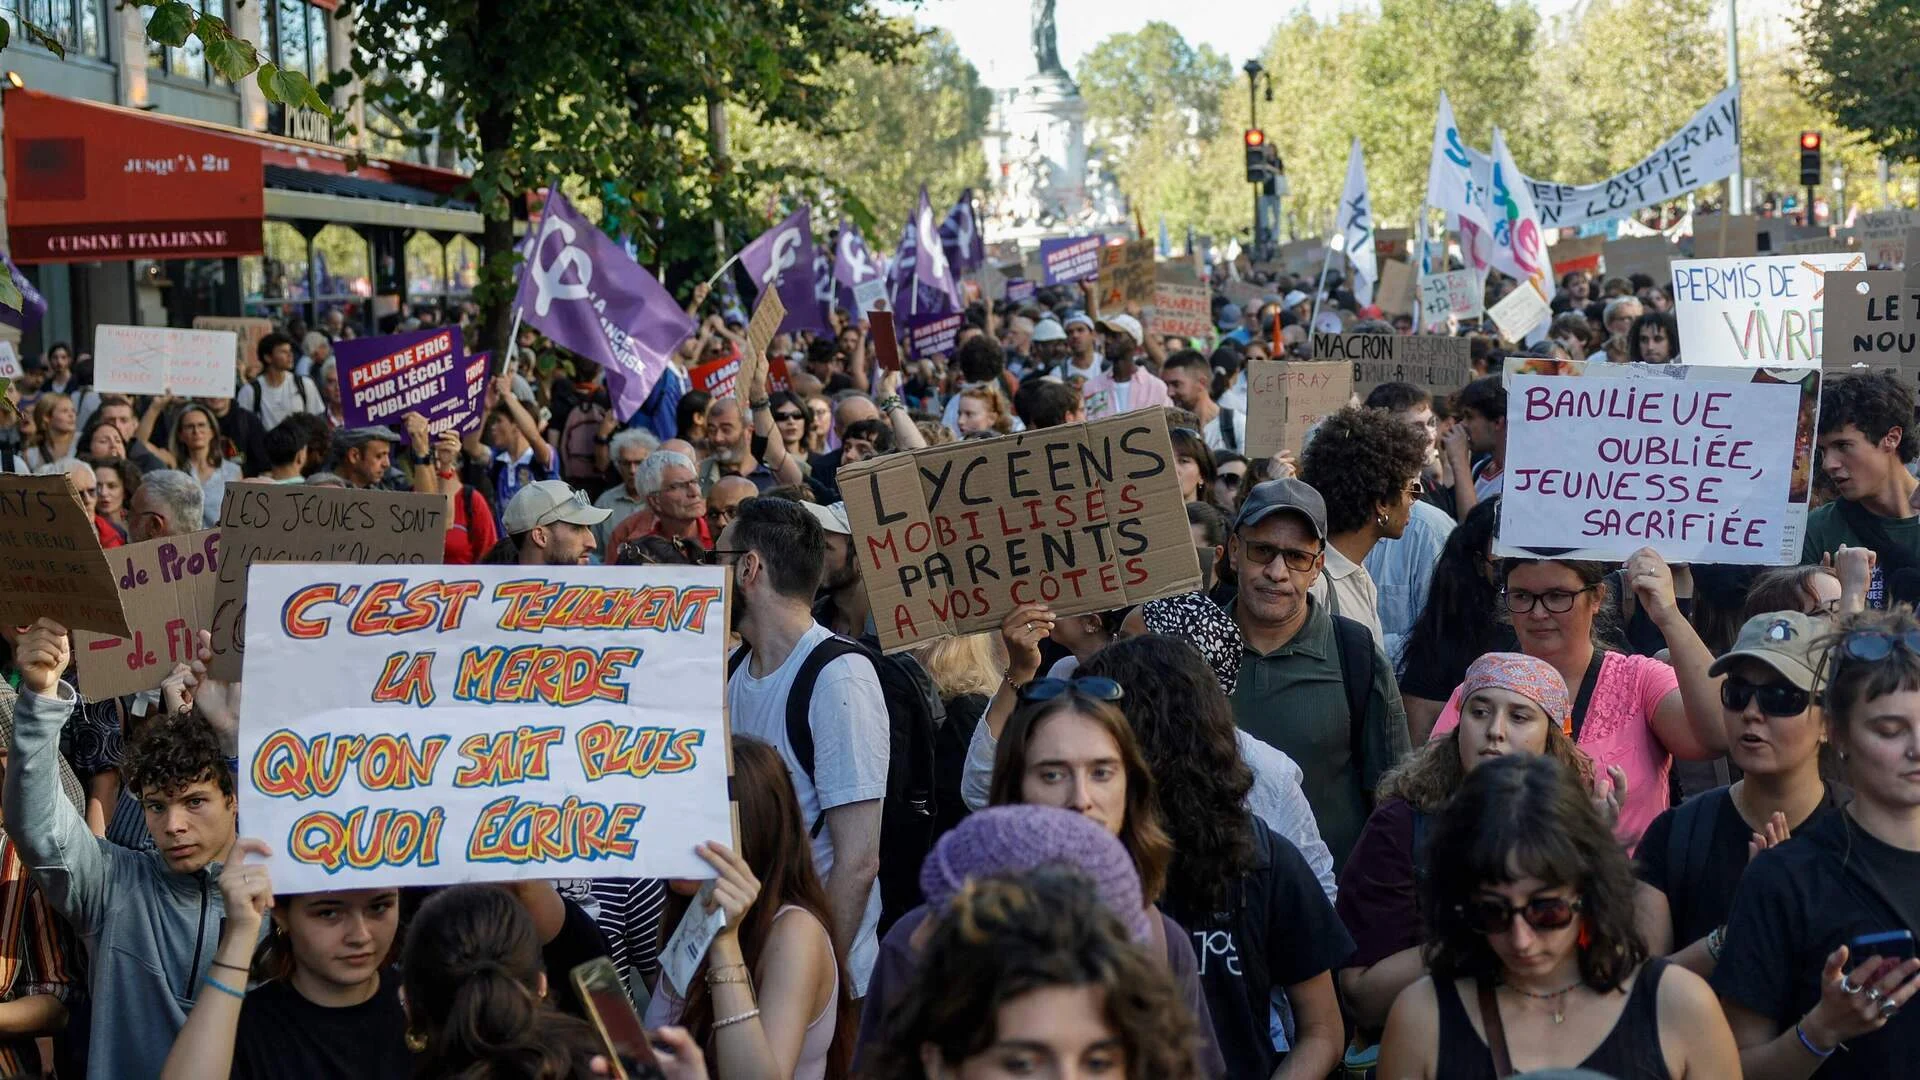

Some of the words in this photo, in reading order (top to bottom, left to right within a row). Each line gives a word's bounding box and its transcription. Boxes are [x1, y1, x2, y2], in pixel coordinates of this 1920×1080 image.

[124, 153, 196, 175] JUSQU'À
[48, 233, 122, 251] CUISINE
[129, 231, 227, 248] ITALIENNE
[1768, 265, 1799, 297] DE
[1867, 295, 1899, 321] LE
[352, 359, 392, 386] PLUS
[394, 350, 414, 370] DE
[416, 335, 449, 361] FRIC
[1313, 334, 1393, 359] MACRON
[354, 379, 396, 408] POUR
[398, 355, 454, 391] L'ÉCOLE
[466, 359, 485, 384] FRIC
[367, 382, 438, 421] PUBLIQUE
[439, 376, 446, 391] !
[1526, 387, 1732, 429] BANLIEUE
[870, 427, 1166, 526] LYCÉENS
[1514, 469, 1723, 503] JEUNESSE
[283, 493, 375, 531] JEUNES
[390, 504, 441, 533] SONT
[866, 479, 1144, 570] MOBILISÉS
[1582, 508, 1767, 547] SACRIFIÉE
[120, 557, 149, 590] de
[158, 533, 221, 583] Prof
[897, 518, 1149, 598] PARENTS
[281, 579, 484, 640] C'EST
[492, 579, 723, 634] TELLEMENT
[894, 603, 919, 640] A
[928, 586, 991, 623] VOS
[1010, 554, 1149, 606] CÔTÉS
[127, 631, 157, 670] de
[371, 649, 437, 707] LA
[454, 645, 643, 705] MERDE
[252, 728, 452, 799] QU'ON
[576, 720, 704, 783] PLUS
[288, 806, 446, 875] QUOI
